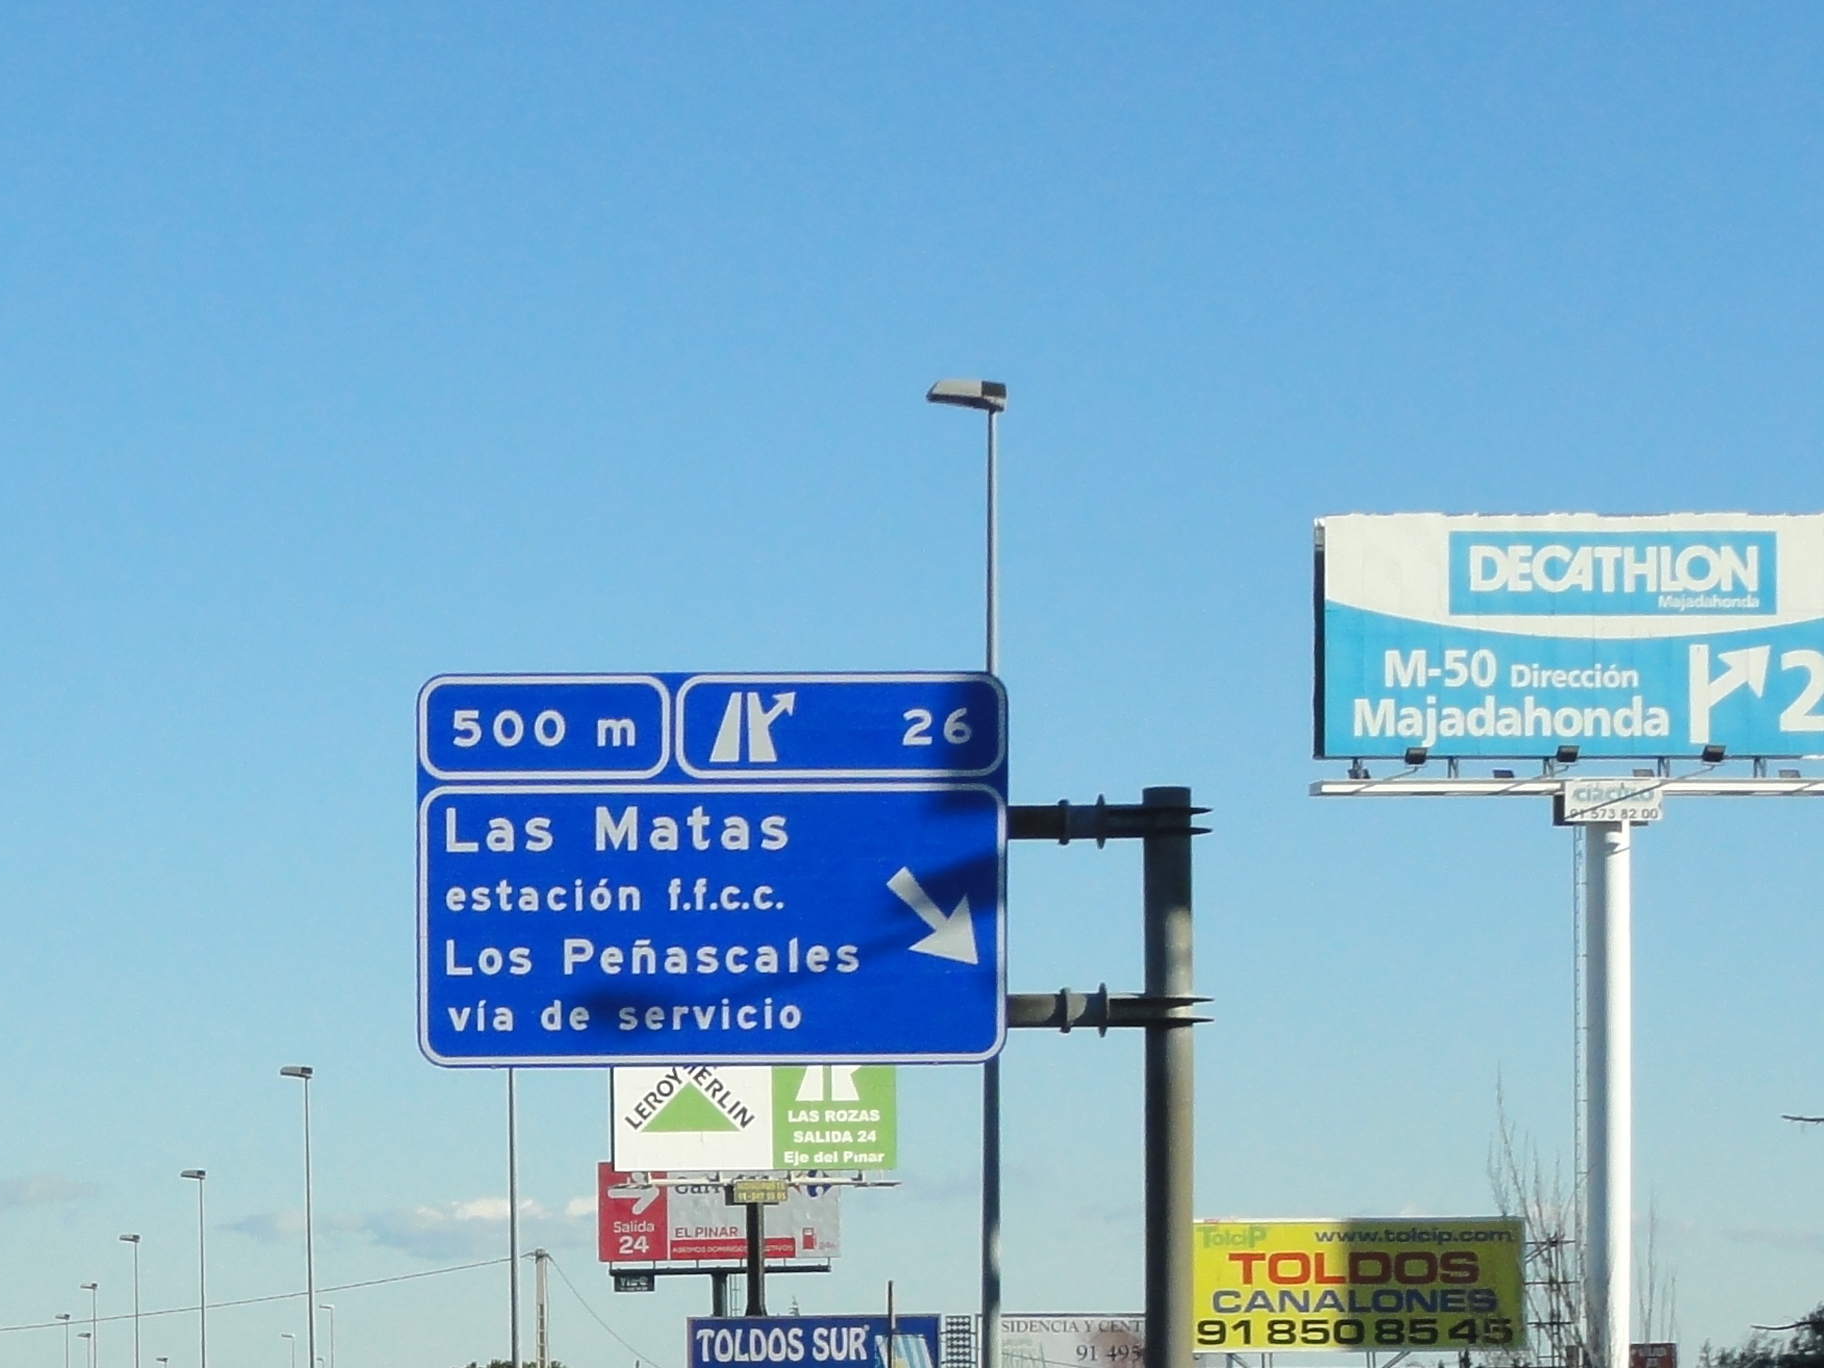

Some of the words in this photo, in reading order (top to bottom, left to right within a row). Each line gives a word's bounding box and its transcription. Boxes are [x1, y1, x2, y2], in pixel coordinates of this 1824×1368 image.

[1468, 545, 1759, 593] DECATHLON
[1658, 594, 1760, 612] Majadahonda
[1384, 649, 1497, 688] M-50
[1510, 664, 1639, 689] Dirección
[1779, 649, 1824, 732] 2
[452, 709, 566, 749] 500
[597, 717, 637, 748] m
[902, 708, 972, 747] 26
[1353, 696, 1669, 747] Majadahonda
[445, 807, 553, 853] Las
[595, 805, 789, 852] Matas
[1590, 808, 1616, 820] 573
[1620, 808, 1637, 819] 82
[1641, 808, 1659, 819] 00
[445, 878, 641, 912] estación
[669, 878, 785, 911] f.f.c.c.
[445, 939, 532, 976] Los
[564, 937, 861, 976] Peñascales
[448, 1001, 514, 1033] vía
[541, 999, 589, 1031] de
[619, 998, 803, 1032] servicio
[624, 1066, 683, 1130] LEROY
[788, 1110, 820, 1122] LAS
[825, 1109, 881, 1122] ROZAS
[793, 1130, 854, 1143] SALIDA
[857, 1130, 877, 1142] 24
[784, 1151, 810, 1166] Eje
[813, 1151, 838, 1163] del
[843, 1151, 885, 1163] Pinar
[613, 1220, 655, 1233] Salida
[675, 1227, 693, 1238] EL
[695, 1226, 739, 1238] PINAR
[1314, 1227, 1512, 1246] www.tolcip.com
[619, 1235, 650, 1254] 24
[1228, 1250, 1480, 1285] TOLDOS
[1212, 1288, 1498, 1314] CANALONES
[1000, 1320, 1079, 1333] SIDENCIA
[1082, 1320, 1094, 1333] Y
[1098, 1320, 1144, 1333] CENT
[1197, 1319, 1252, 1345] 91
[1267, 1318, 1366, 1345] 850
[1374, 1318, 1439, 1345] 85
[1448, 1318, 1514, 1344] 45
[696, 1327, 805, 1362] TOLDOS
[812, 1327, 868, 1361] SUR
[1076, 1344, 1097, 1362] 91
